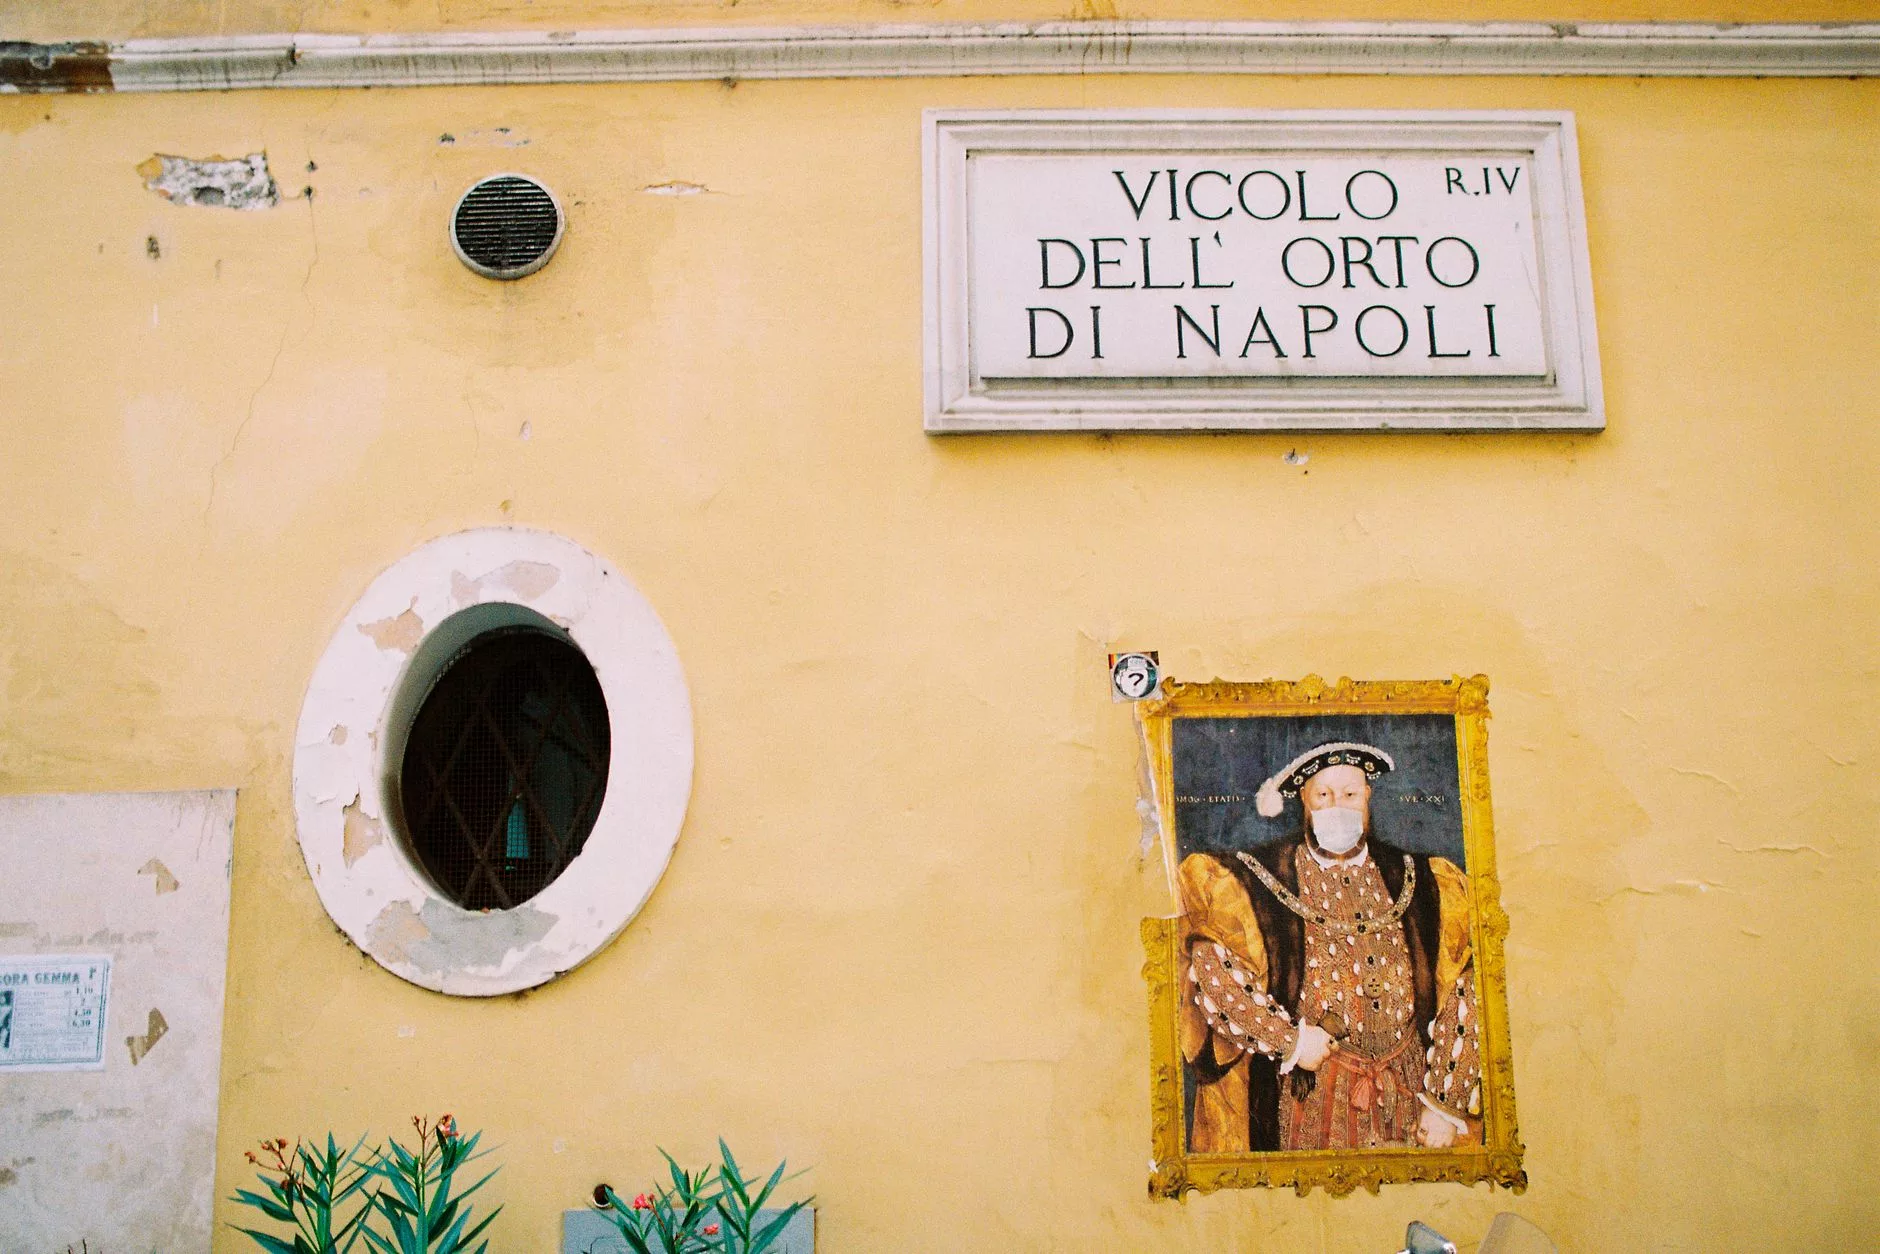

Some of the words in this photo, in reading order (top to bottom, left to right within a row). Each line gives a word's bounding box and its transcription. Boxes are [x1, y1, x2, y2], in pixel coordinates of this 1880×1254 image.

[1111, 169, 1399, 221] VICOLO
[1037, 231, 1234, 290] DELL'
[1281, 235, 1480, 290] ORTO
[1025, 305, 1105, 359] DI
[1173, 304, 1502, 359] NAPOLI
[34, 971, 80, 985] GEMMA
